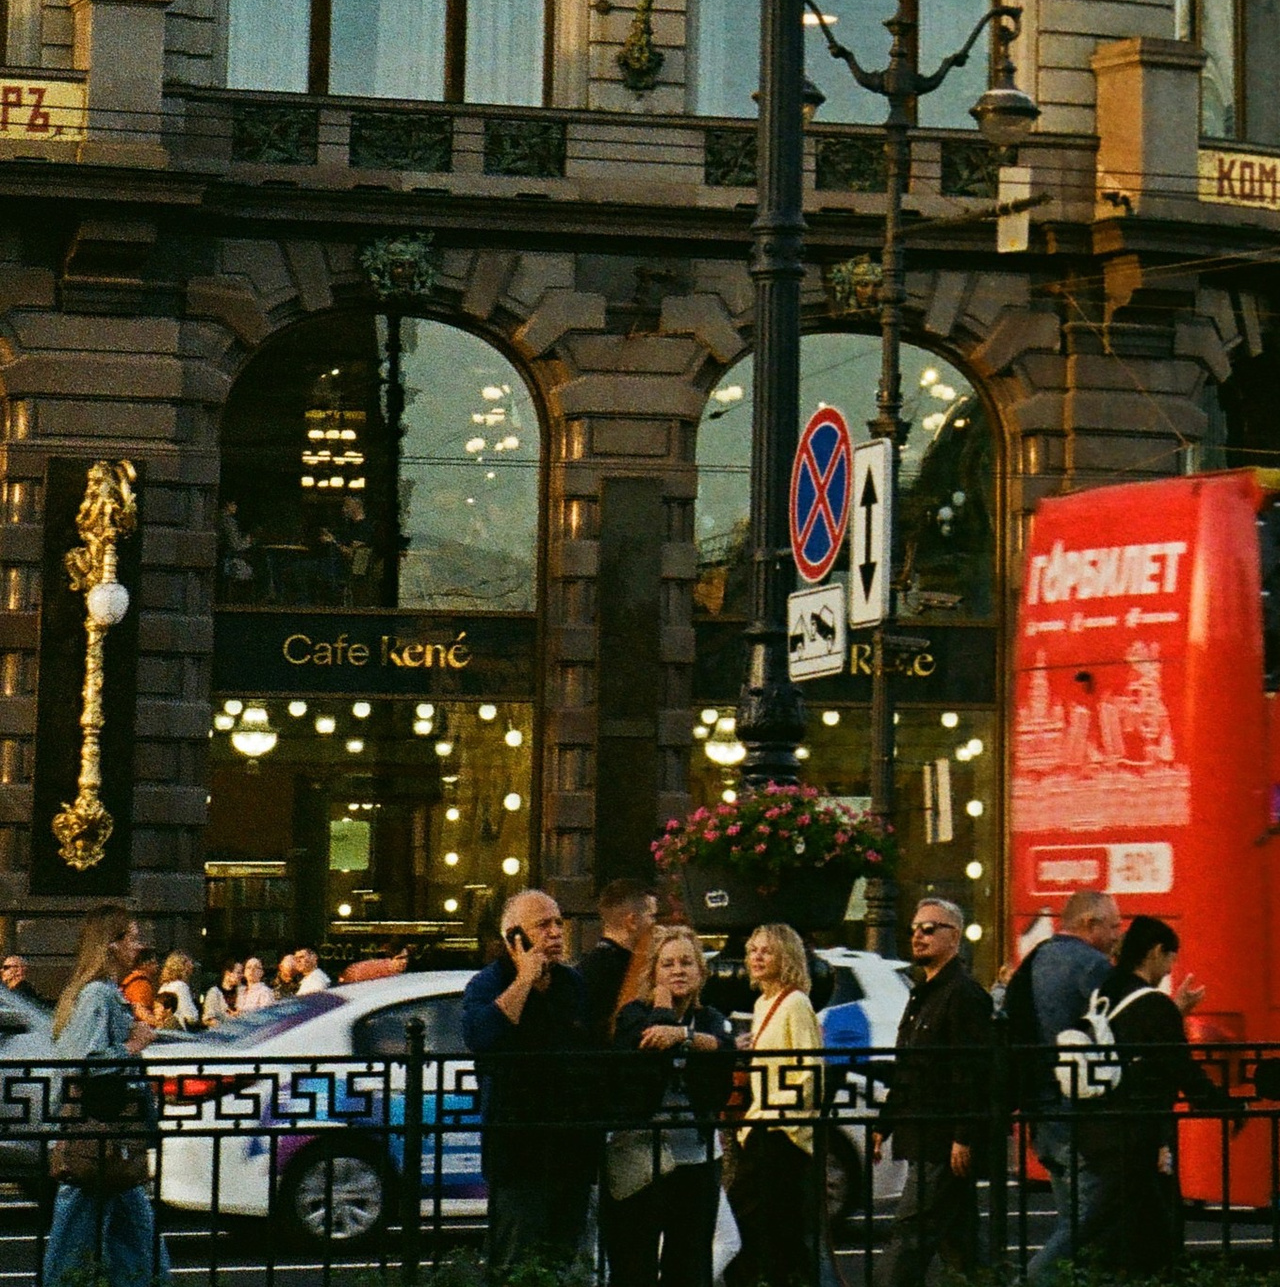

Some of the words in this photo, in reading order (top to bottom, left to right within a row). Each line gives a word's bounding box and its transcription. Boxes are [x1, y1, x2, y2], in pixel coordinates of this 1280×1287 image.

[1027, 539, 1187, 606] ГОРБИЛЕТ
[282, 633, 370, 665] Cafe
[380, 630, 474, 668] René
